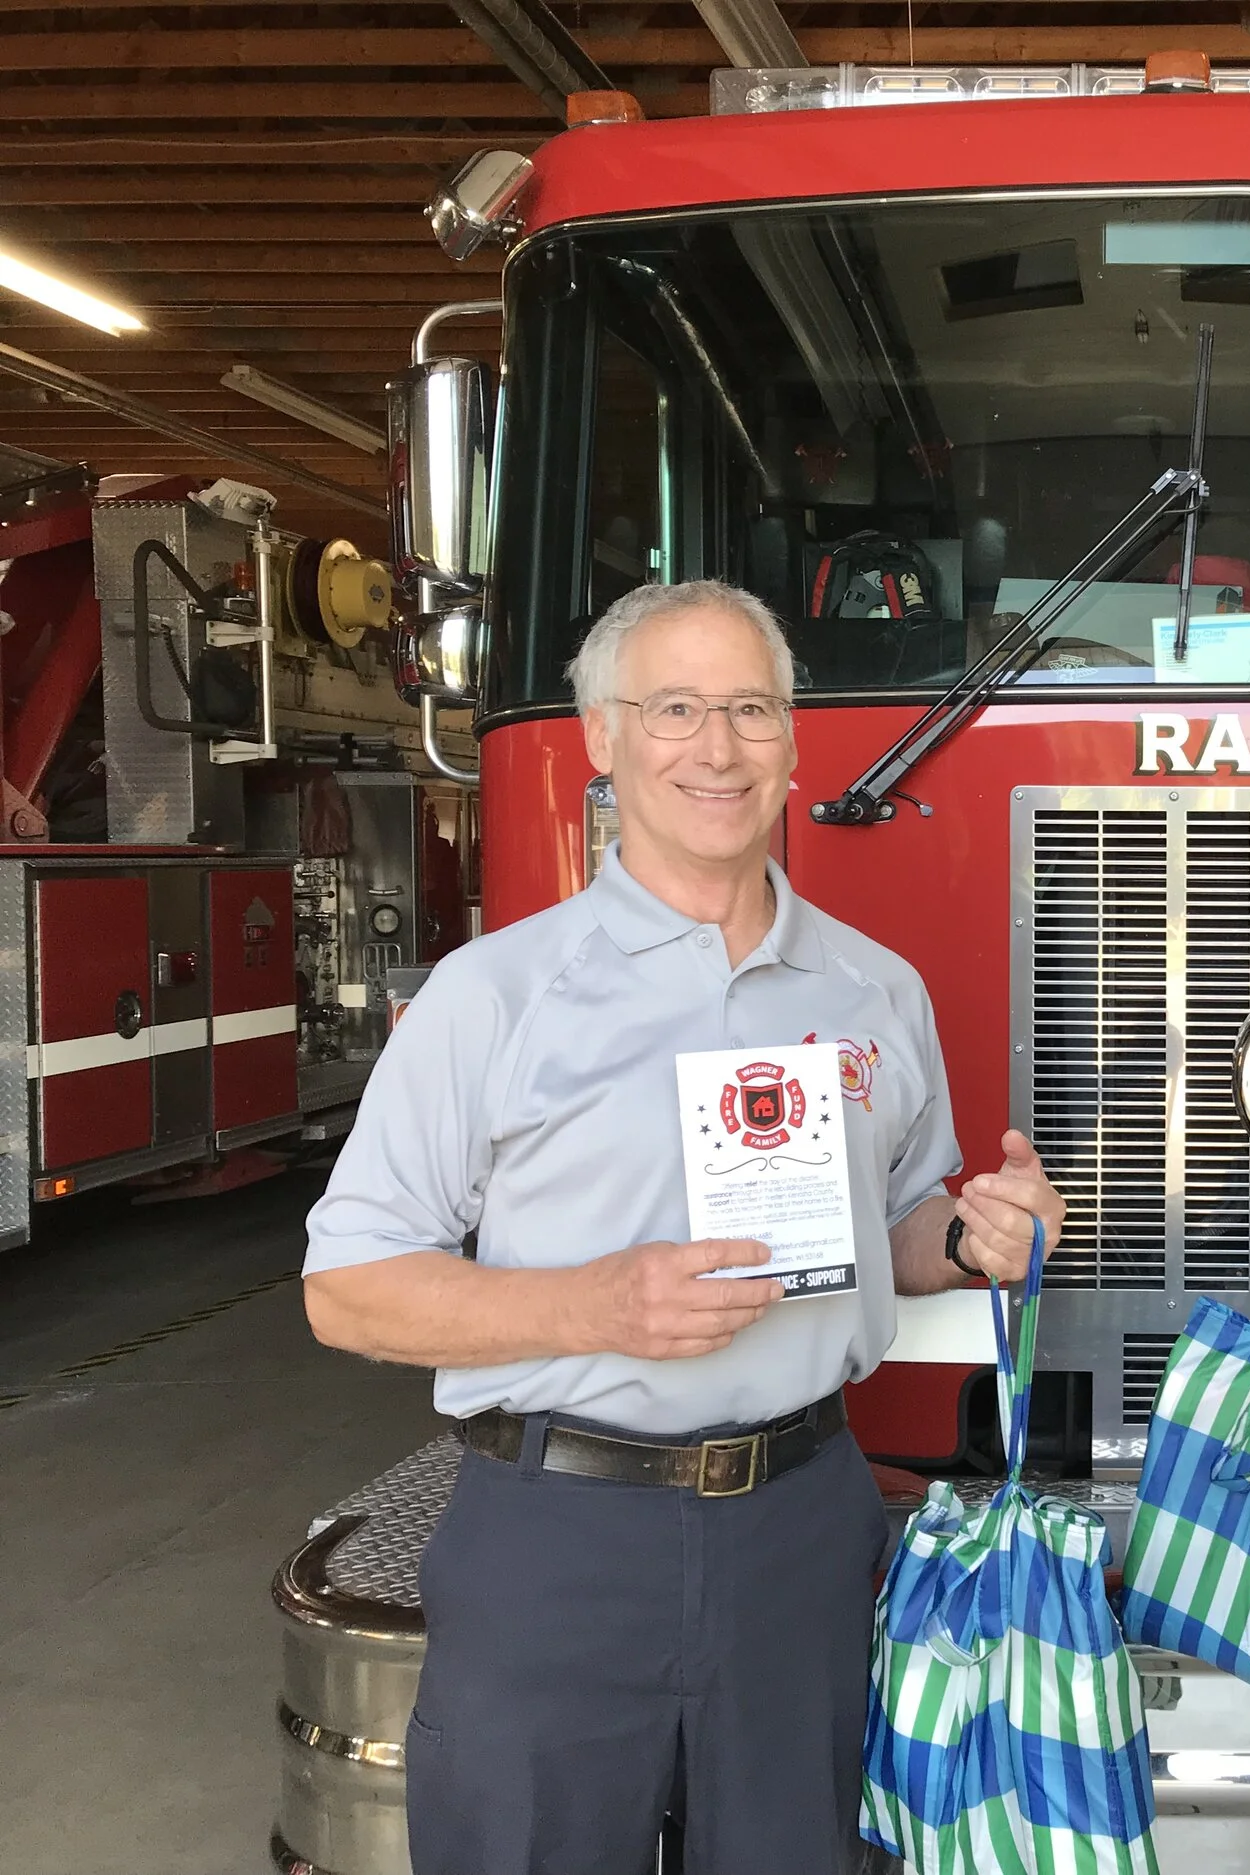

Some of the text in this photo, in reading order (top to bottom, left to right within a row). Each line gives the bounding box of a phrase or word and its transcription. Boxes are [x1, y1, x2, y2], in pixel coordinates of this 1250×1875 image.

[900, 572, 925, 607] 3M
[741, 1065, 778, 1077] WAGNER
[724, 1091, 734, 1126] FIRE
[791, 1086, 802, 1120] FUND
[749, 1134, 782, 1146] FAMILY
[806, 1268, 846, 1287] SUPPORT
